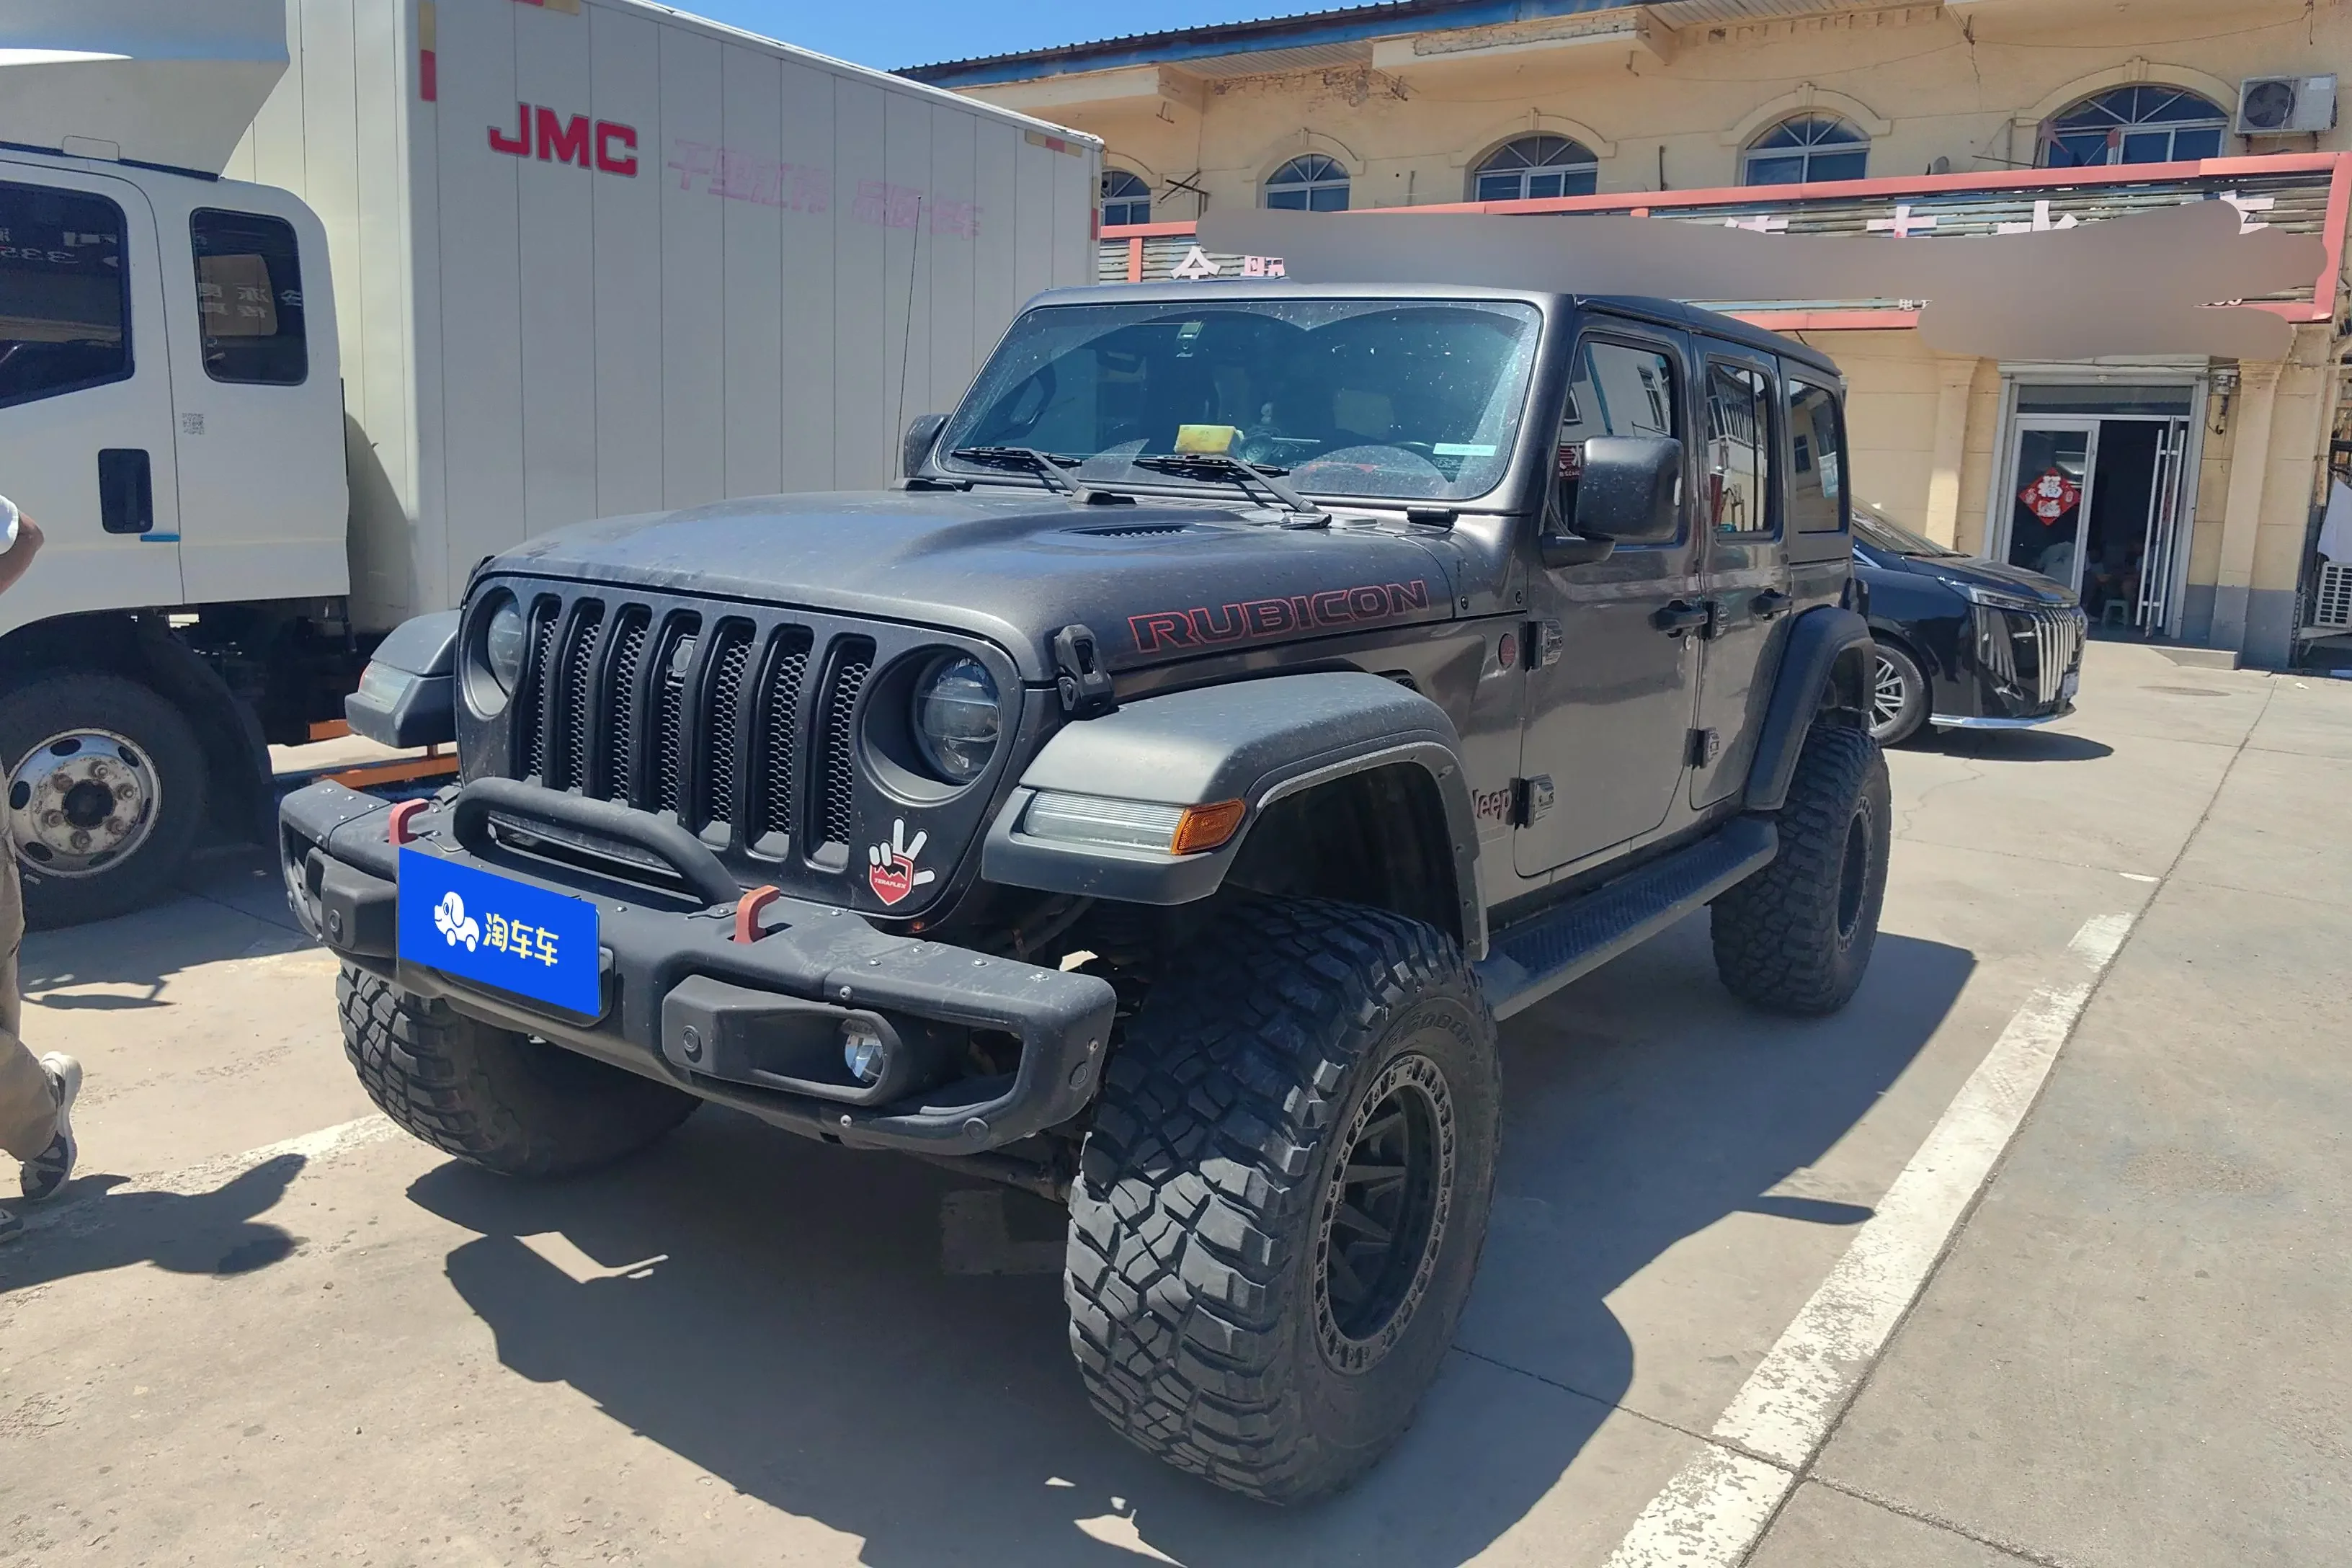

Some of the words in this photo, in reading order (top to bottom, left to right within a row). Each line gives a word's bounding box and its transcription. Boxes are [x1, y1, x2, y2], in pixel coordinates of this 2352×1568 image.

[486, 102, 638, 178] JMC
[1127, 579, 1430, 654] RUBICON
[874, 878, 906, 889] TERAPLEX
